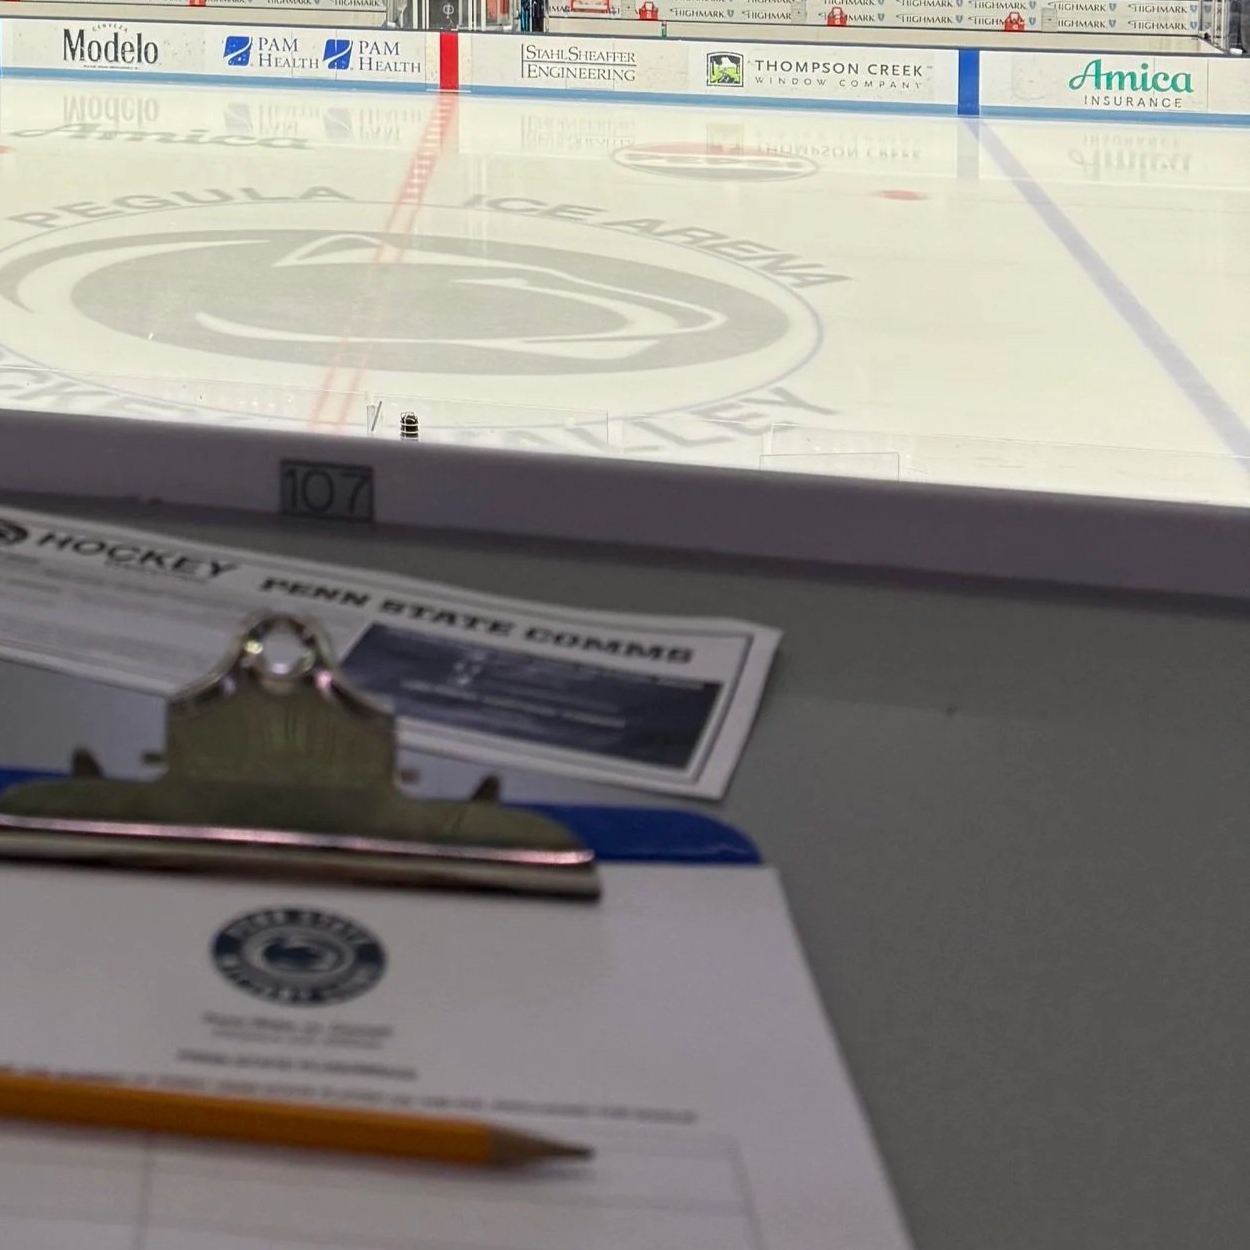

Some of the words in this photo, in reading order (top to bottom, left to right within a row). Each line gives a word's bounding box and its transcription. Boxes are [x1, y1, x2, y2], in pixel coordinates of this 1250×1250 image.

[63, 29, 158, 64] Modelo
[259, 37, 299, 52] PAM
[359, 41, 399, 56] PAM
[527, 64, 635, 81] ENGINEERING
[755, 60, 859, 75] THOMPSON
[868, 64, 922, 77] CREEK
[1069, 59, 1194, 94] Amica
[755, 77, 826, 86] WINDOW
[839, 79, 922, 89] COMPANY
[1084, 95, 1182, 108] INSURANCE
[6, 186, 355, 229] PEGULA
[459, 194, 608, 221] ICE
[601, 217, 854, 290] ARENA
[283, 468, 370, 514] 107
[36, 531, 241, 579] HOCKEY
[258, 576, 369, 609] PENN
[376, 598, 514, 638] STATE
[525, 626, 696, 665] COMMS
